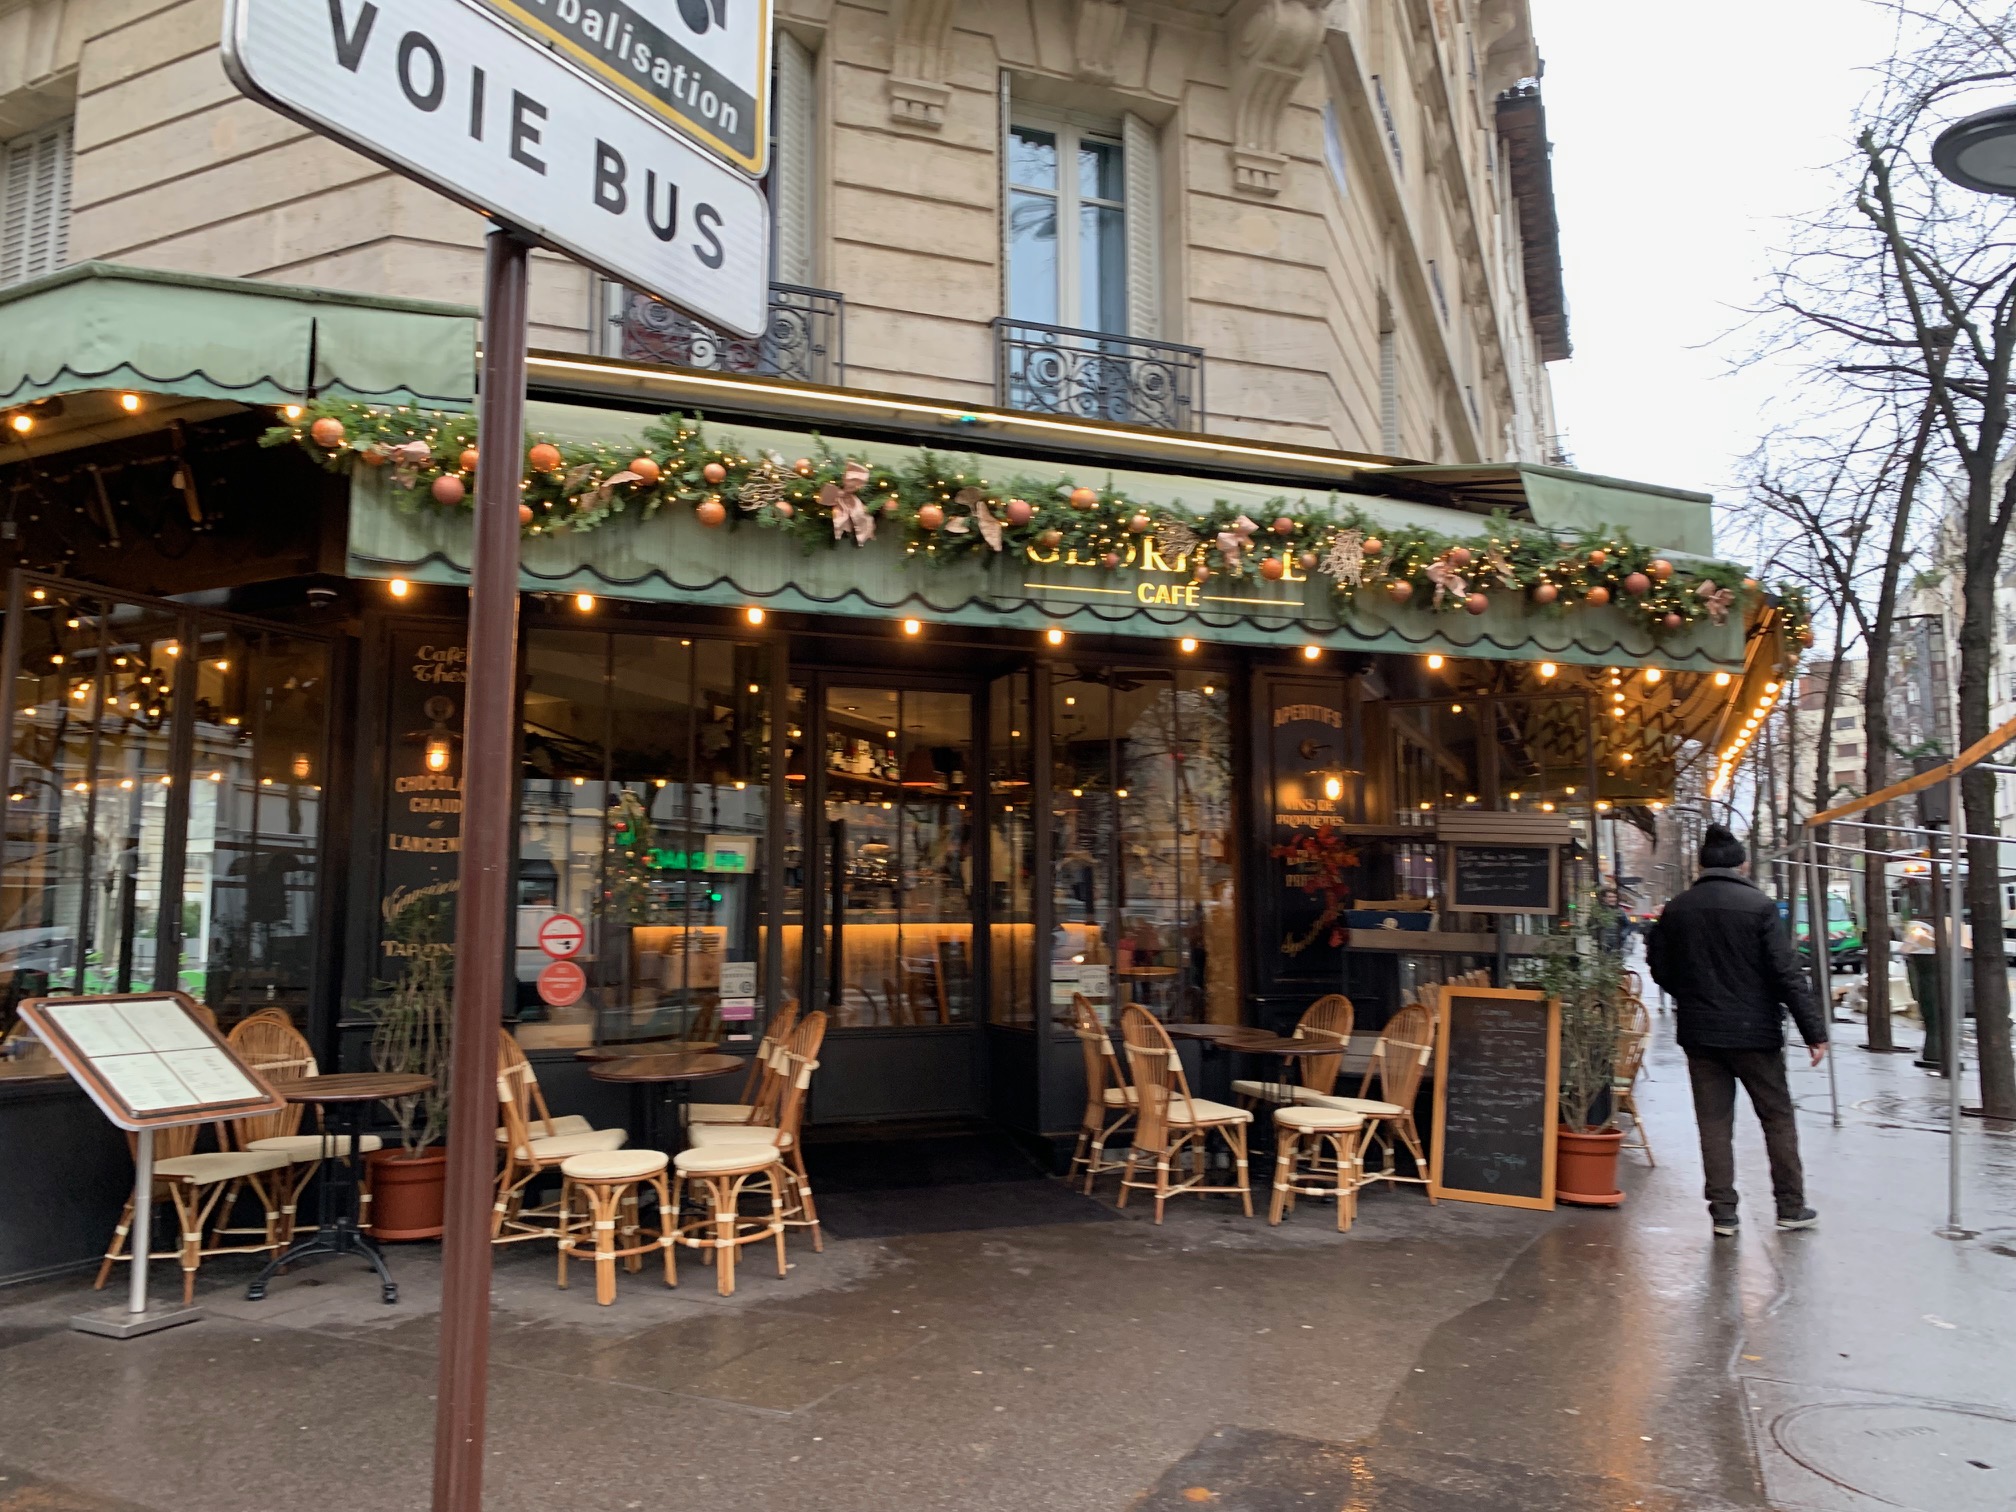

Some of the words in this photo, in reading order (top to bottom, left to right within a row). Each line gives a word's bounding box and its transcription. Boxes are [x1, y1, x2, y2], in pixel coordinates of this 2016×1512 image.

[536, 0, 739, 134] balisation
[327, 0, 548, 177] VOIE
[594, 137, 725, 270] BUS
[1137, 580, 1201, 608] CAFÉ
